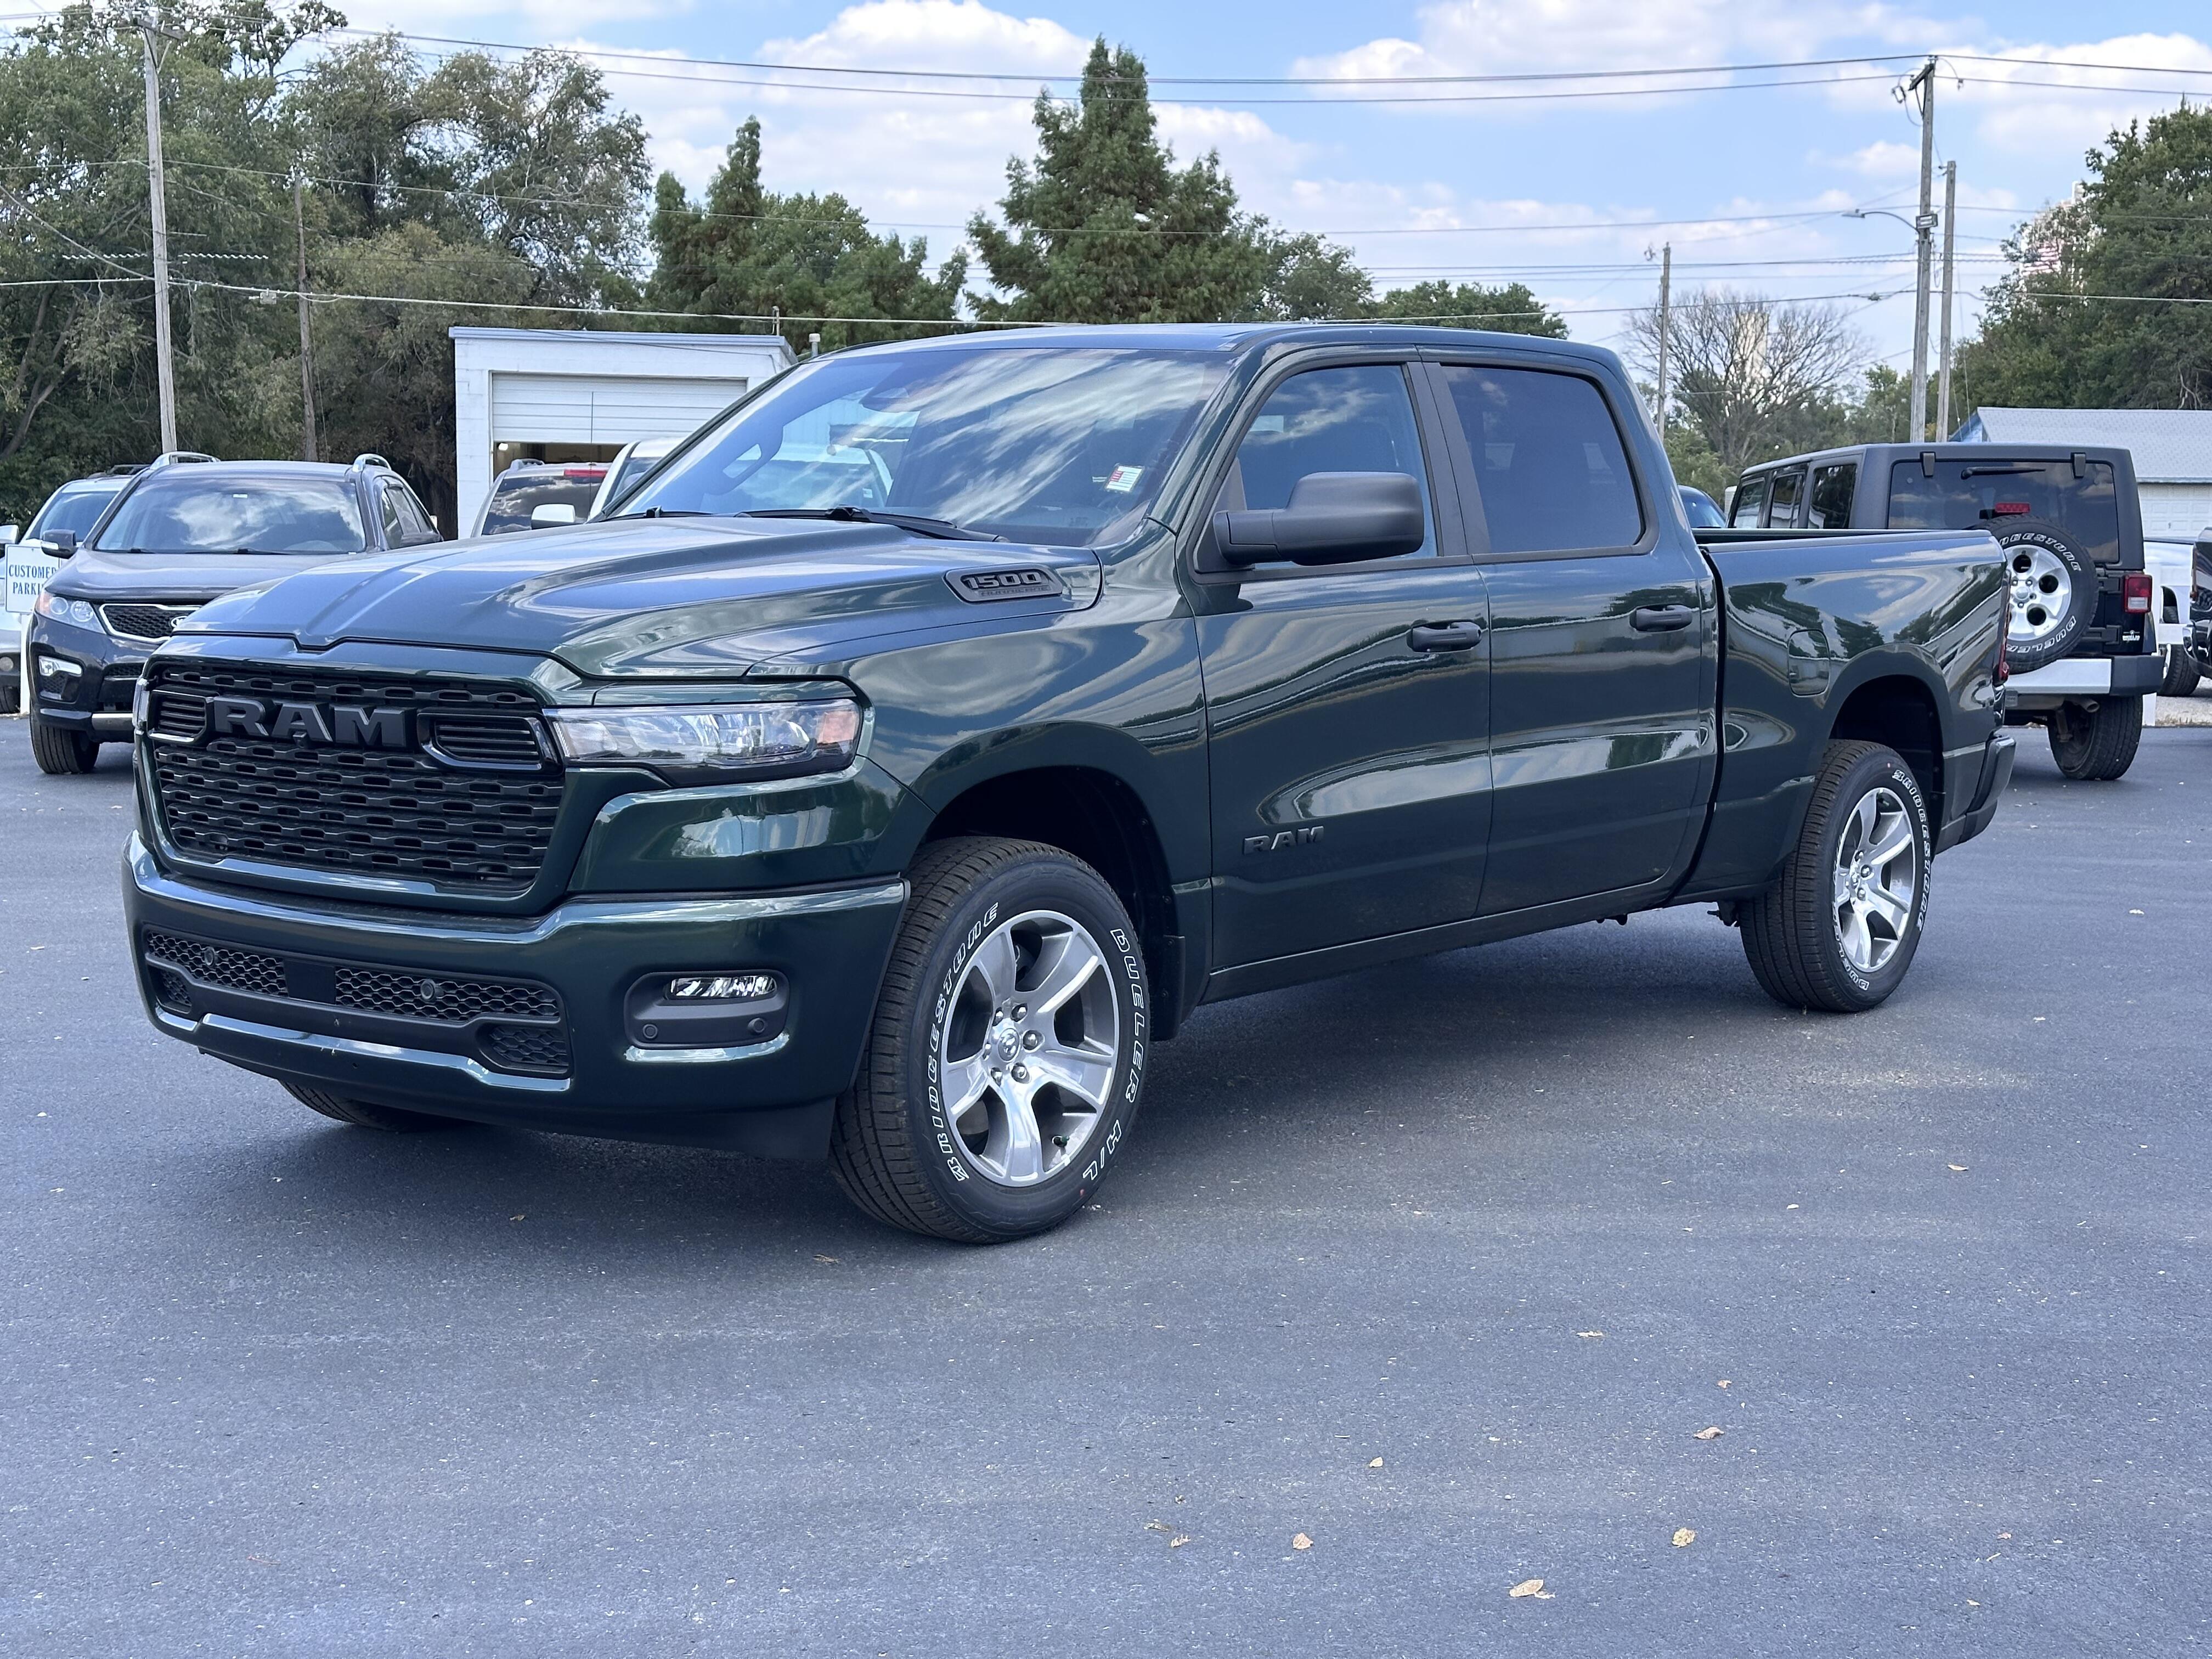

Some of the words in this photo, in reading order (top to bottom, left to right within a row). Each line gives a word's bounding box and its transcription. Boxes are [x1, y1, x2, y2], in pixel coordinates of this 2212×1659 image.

[1999, 533, 2082, 572] DGESTONE
[13, 582, 44, 595] PARKI
[963, 572, 1041, 589] 1500
[213, 696, 411, 748] RAM
[1243, 825, 1324, 856] RAM
[1892, 769, 1931, 932] BRIDGESTONE
[1110, 928, 1146, 1103] DUELER
[928, 902, 999, 1182] BRIDGESTONE
[1082, 1119, 1122, 1181] H/L
